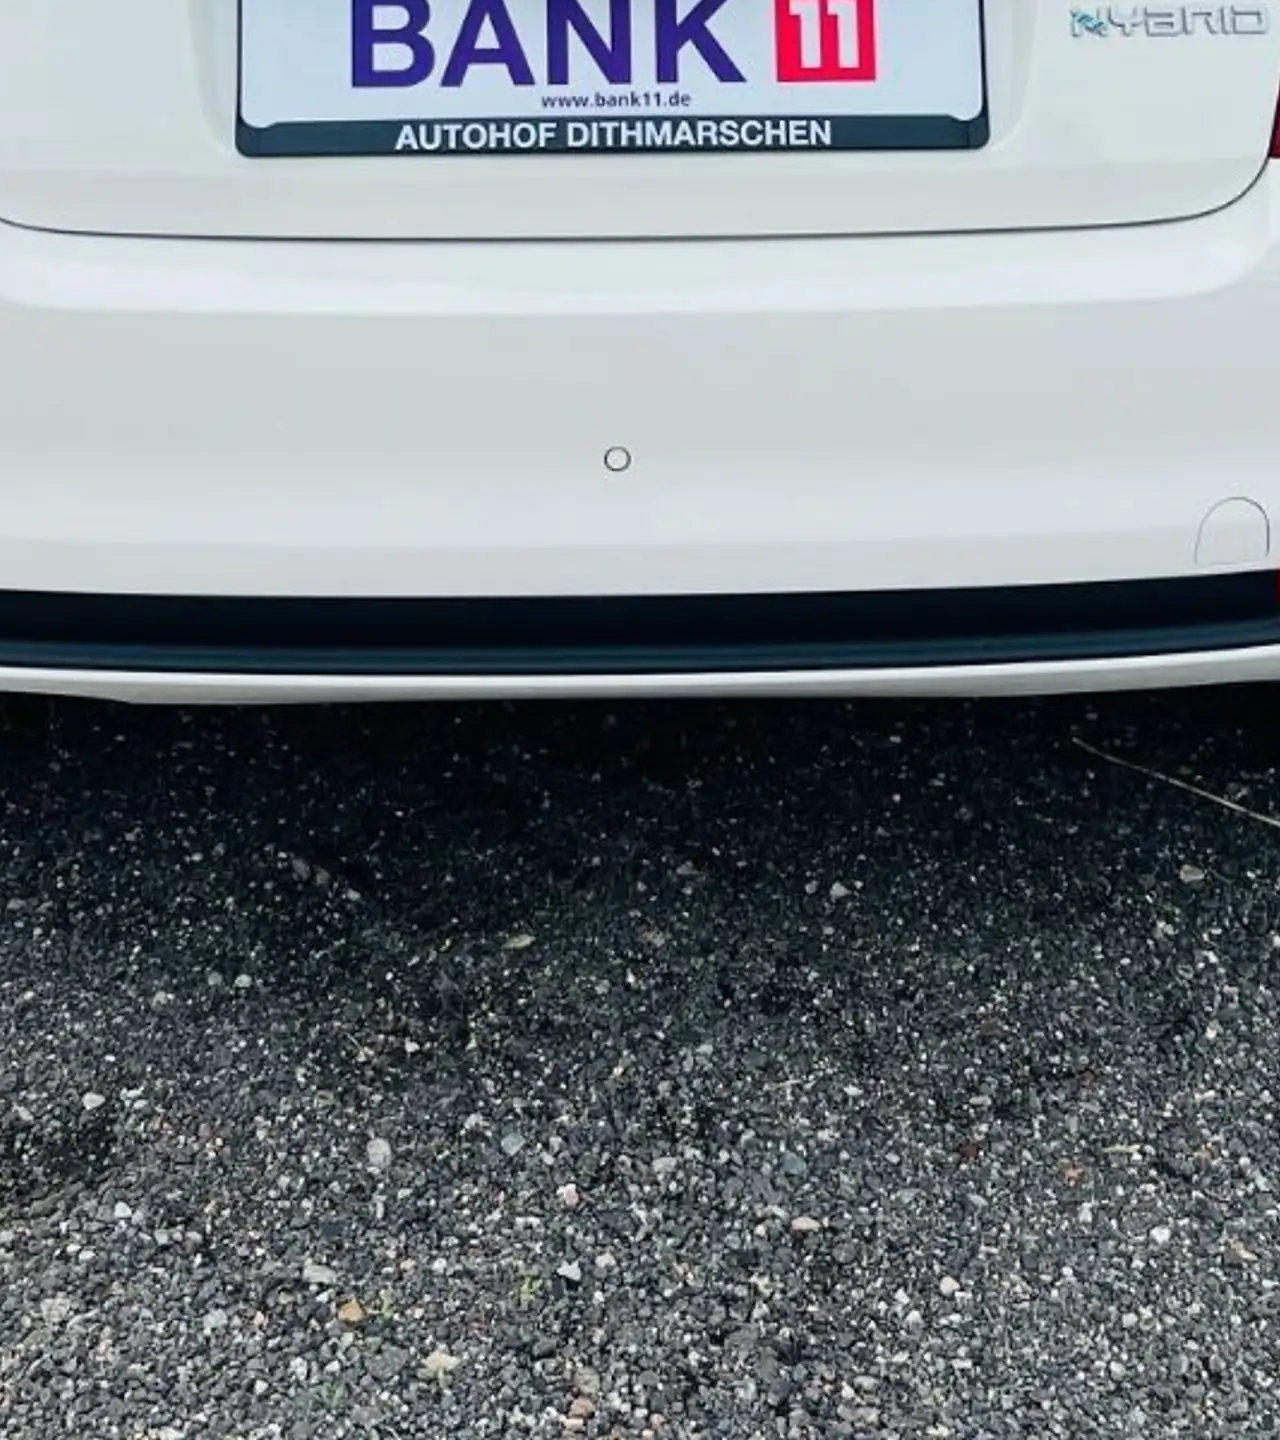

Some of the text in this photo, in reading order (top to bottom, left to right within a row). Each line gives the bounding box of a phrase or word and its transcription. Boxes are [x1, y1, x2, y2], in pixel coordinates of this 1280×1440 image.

[1069, 5, 1270, 38] HYBRID
[541, 90, 692, 109] www.bank11.de
[394, 118, 833, 151] AUTOHOF DITHMARSCHEN
